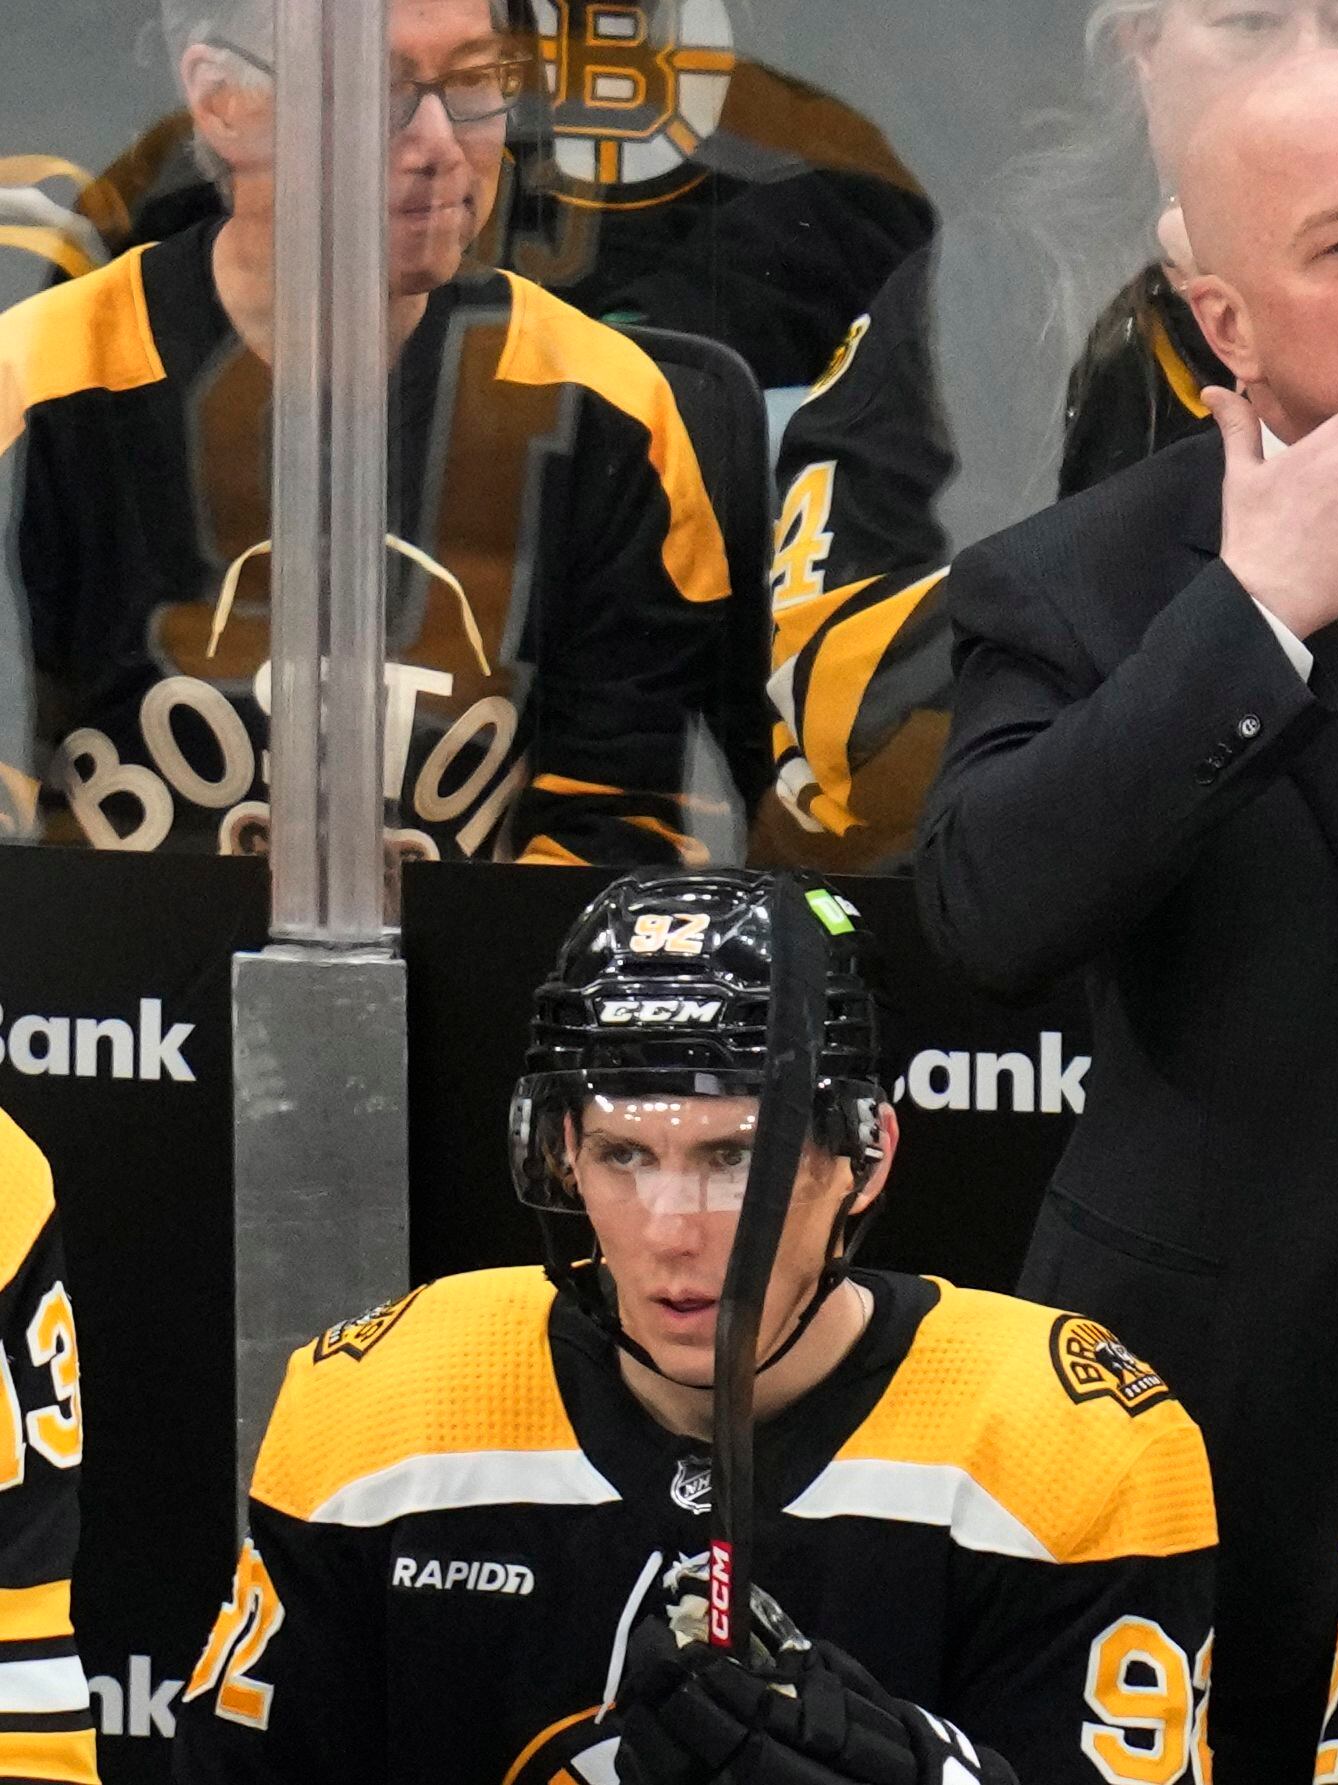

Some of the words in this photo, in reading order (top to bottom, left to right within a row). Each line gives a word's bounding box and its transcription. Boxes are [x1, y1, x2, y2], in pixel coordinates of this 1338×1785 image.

[58, 662, 530, 860] BOTO
[629, 913, 710, 953] 92
[0, 997, 197, 1082] ank
[600, 1000, 722, 1024] CCM
[894, 1030, 1092, 1114] ank
[683, 1472, 712, 1498] NH
[711, 1546, 731, 1640] CCM
